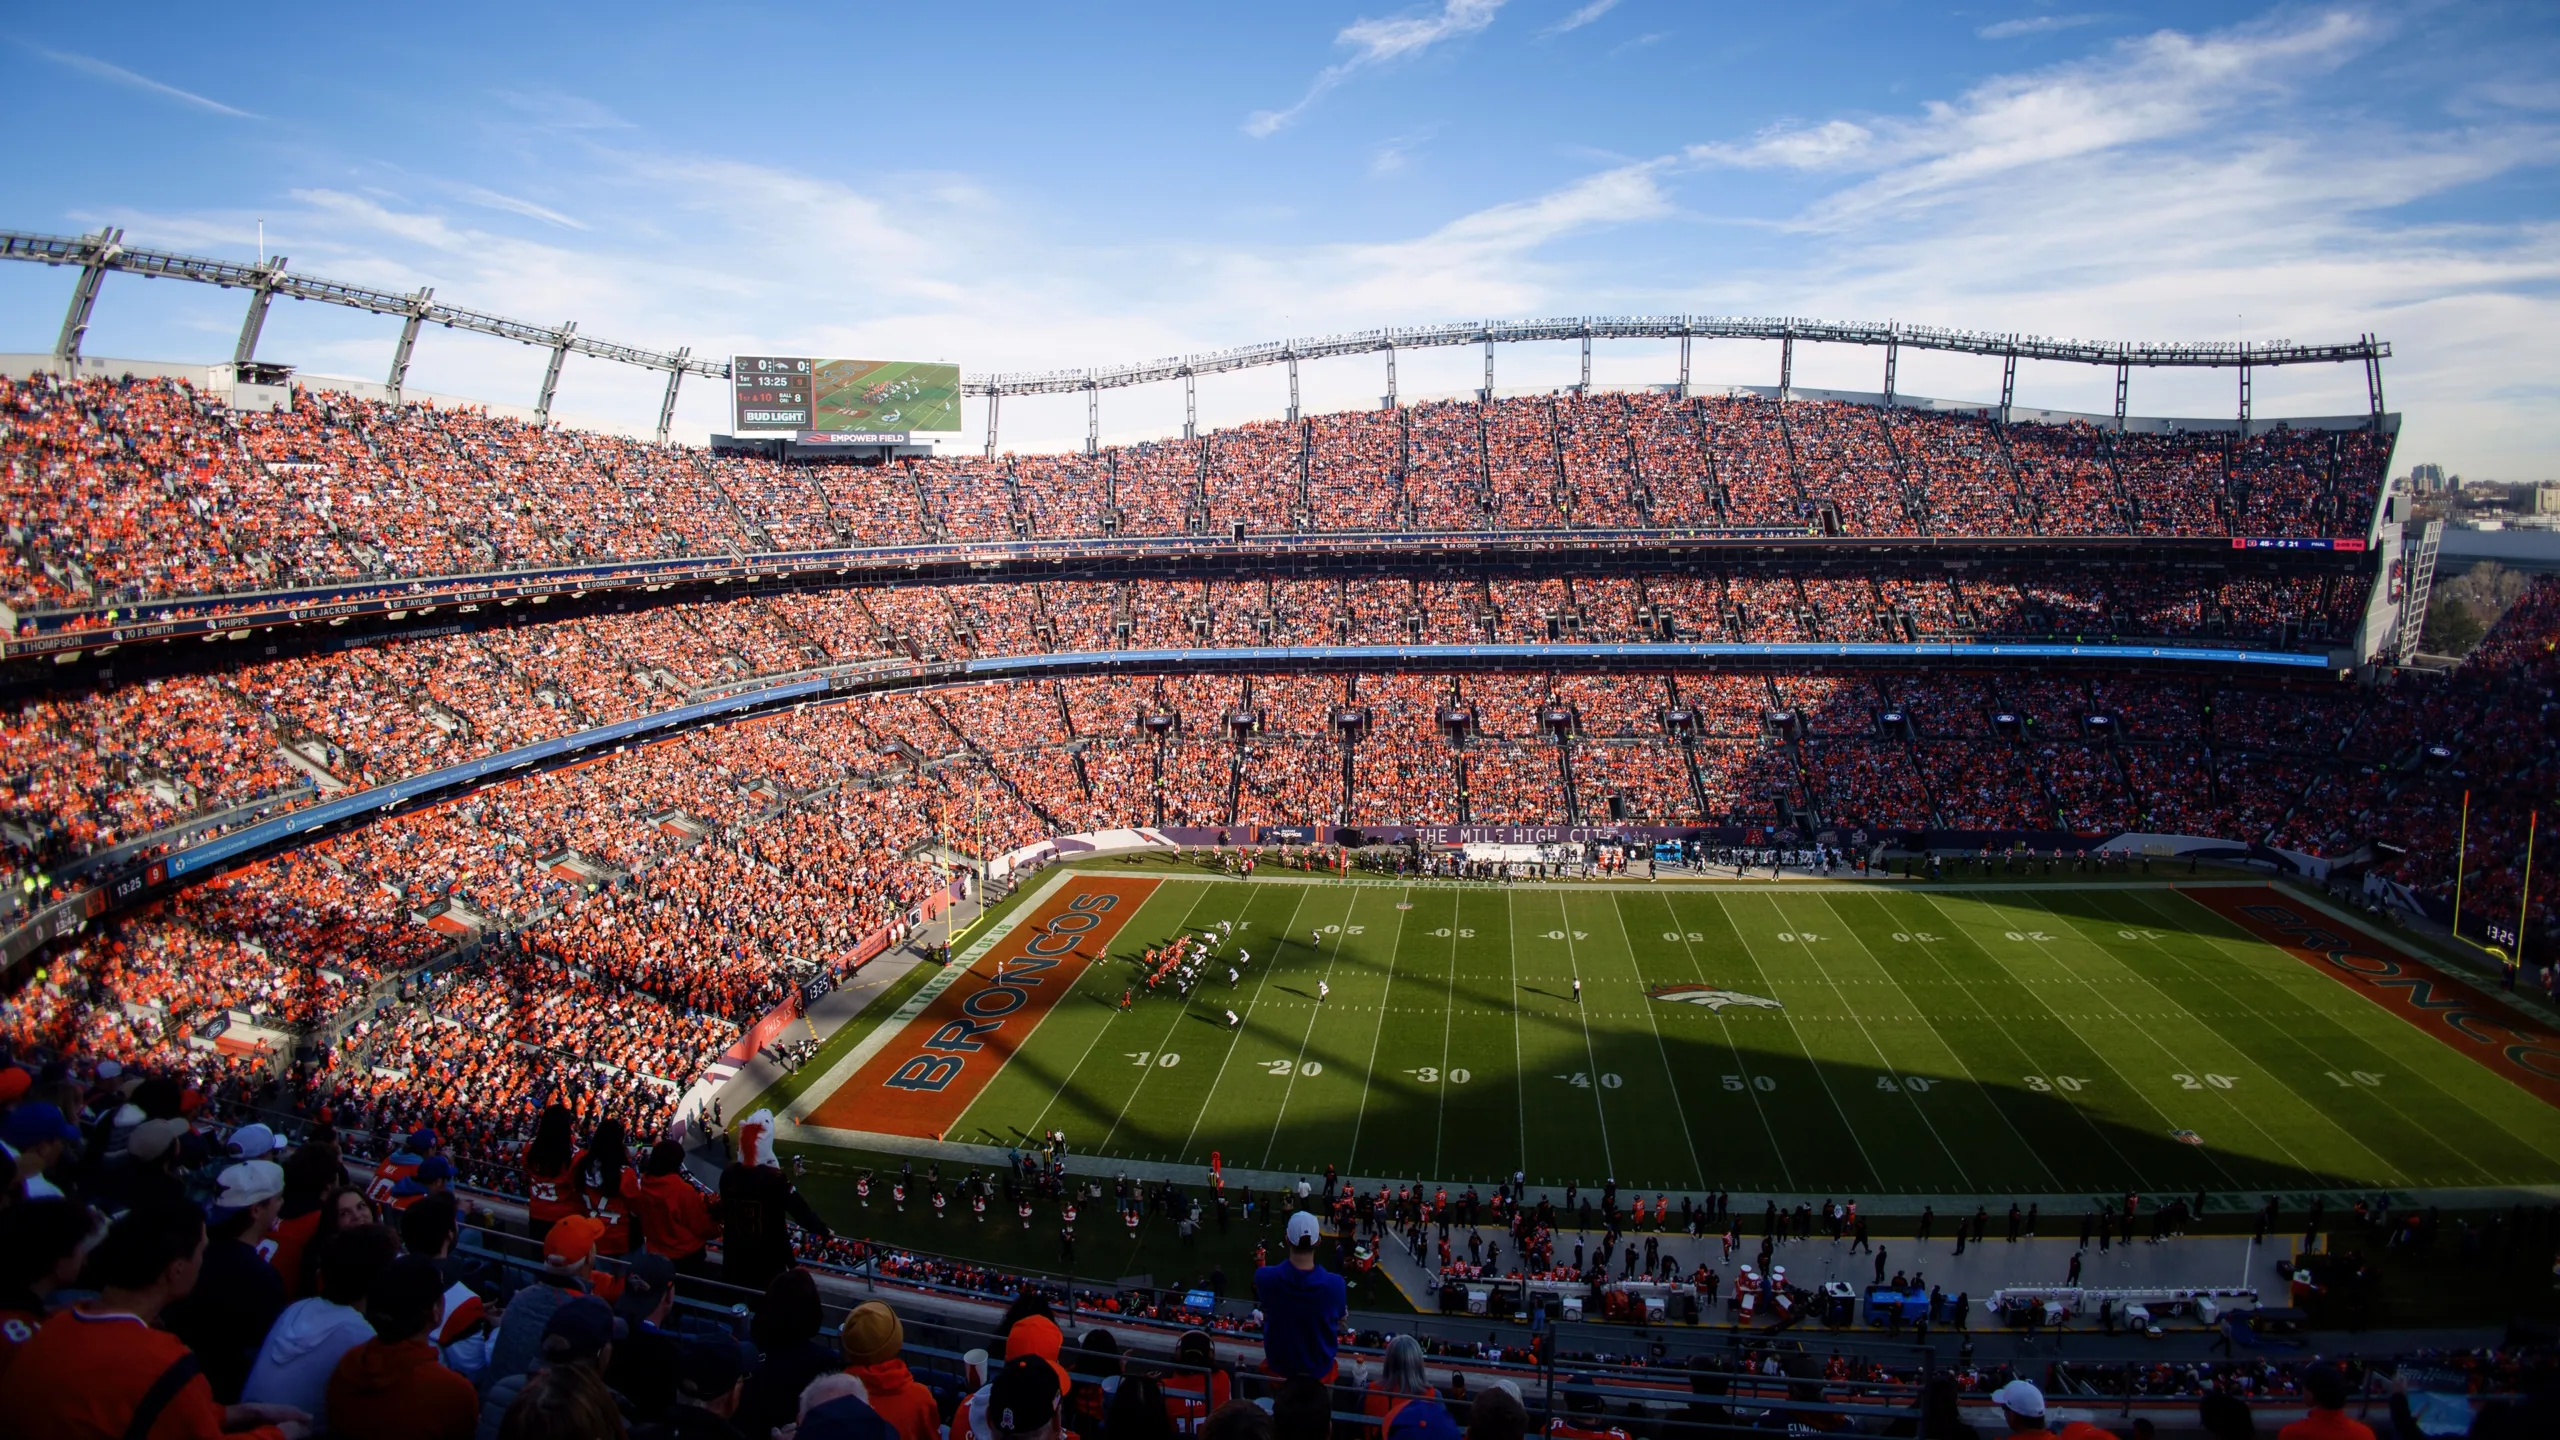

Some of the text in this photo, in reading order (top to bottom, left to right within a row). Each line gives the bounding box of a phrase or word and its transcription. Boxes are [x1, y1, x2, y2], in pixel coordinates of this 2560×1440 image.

[758, 360, 767, 370] 0
[797, 361, 805, 371] 0
[758, 376, 788, 386] 13:25
[760, 393, 772, 402] 10
[795, 394, 801, 402] 8
[746, 412, 804, 421] BUD LIGHT
[831, 434, 877, 442] EMPOWER
[592, 579, 626, 588] GONSOULIN
[468, 592, 489, 600] ELWAY
[406, 598, 433, 606] TAYLOR
[299, 605, 359, 618] 87 R. JACKSON
[218, 617, 249, 628] PHIPPS
[125, 625, 174, 639] 70 P. SMITH
[345, 638, 362, 648] BUD
[440, 625, 461, 635] CLUB
[6, 636, 82, 654] 36 THOMPSON
[868, 674, 872, 682] 0
[892, 669, 911, 678] 13:25
[1415, 828, 1610, 843] THE MILE HIGH CIT
[153, 868, 159, 880] 9
[117, 876, 142, 897] 13:25
[58, 906, 72, 919] 1ST
[36, 925, 43, 936] 0
[1324, 925, 1365, 935] 20
[1434, 928, 1476, 938] 30
[1548, 930, 1588, 940] 40
[2116, 930, 2158, 940] 10
[2486, 924, 2515, 947] 13:25
[1663, 932, 1704, 942] 50
[1778, 932, 1820, 942] 40
[1892, 932, 1936, 942] 30
[2004, 931, 2049, 942] 20
[894, 924, 1014, 1021] IT TAKES ALL OF US
[809, 977, 829, 999] 13:25
[883, 892, 1120, 1092] BRONCOS
[764, 1007, 792, 1037] THIS IS
[1132, 1052, 1181, 1068] 10
[1268, 1060, 1323, 1077] 20
[1416, 1067, 1471, 1084] 30
[1569, 1072, 1623, 1089] 40
[2324, 1070, 2381, 1088] 10
[1721, 1075, 1776, 1092] 50
[1876, 1076, 1930, 1092] 40
[2023, 1075, 2082, 1092] 30
[2172, 1073, 2234, 1090] 20
[383, 1164, 398, 1175] NIX
[3, 1319, 32, 1344] 8
